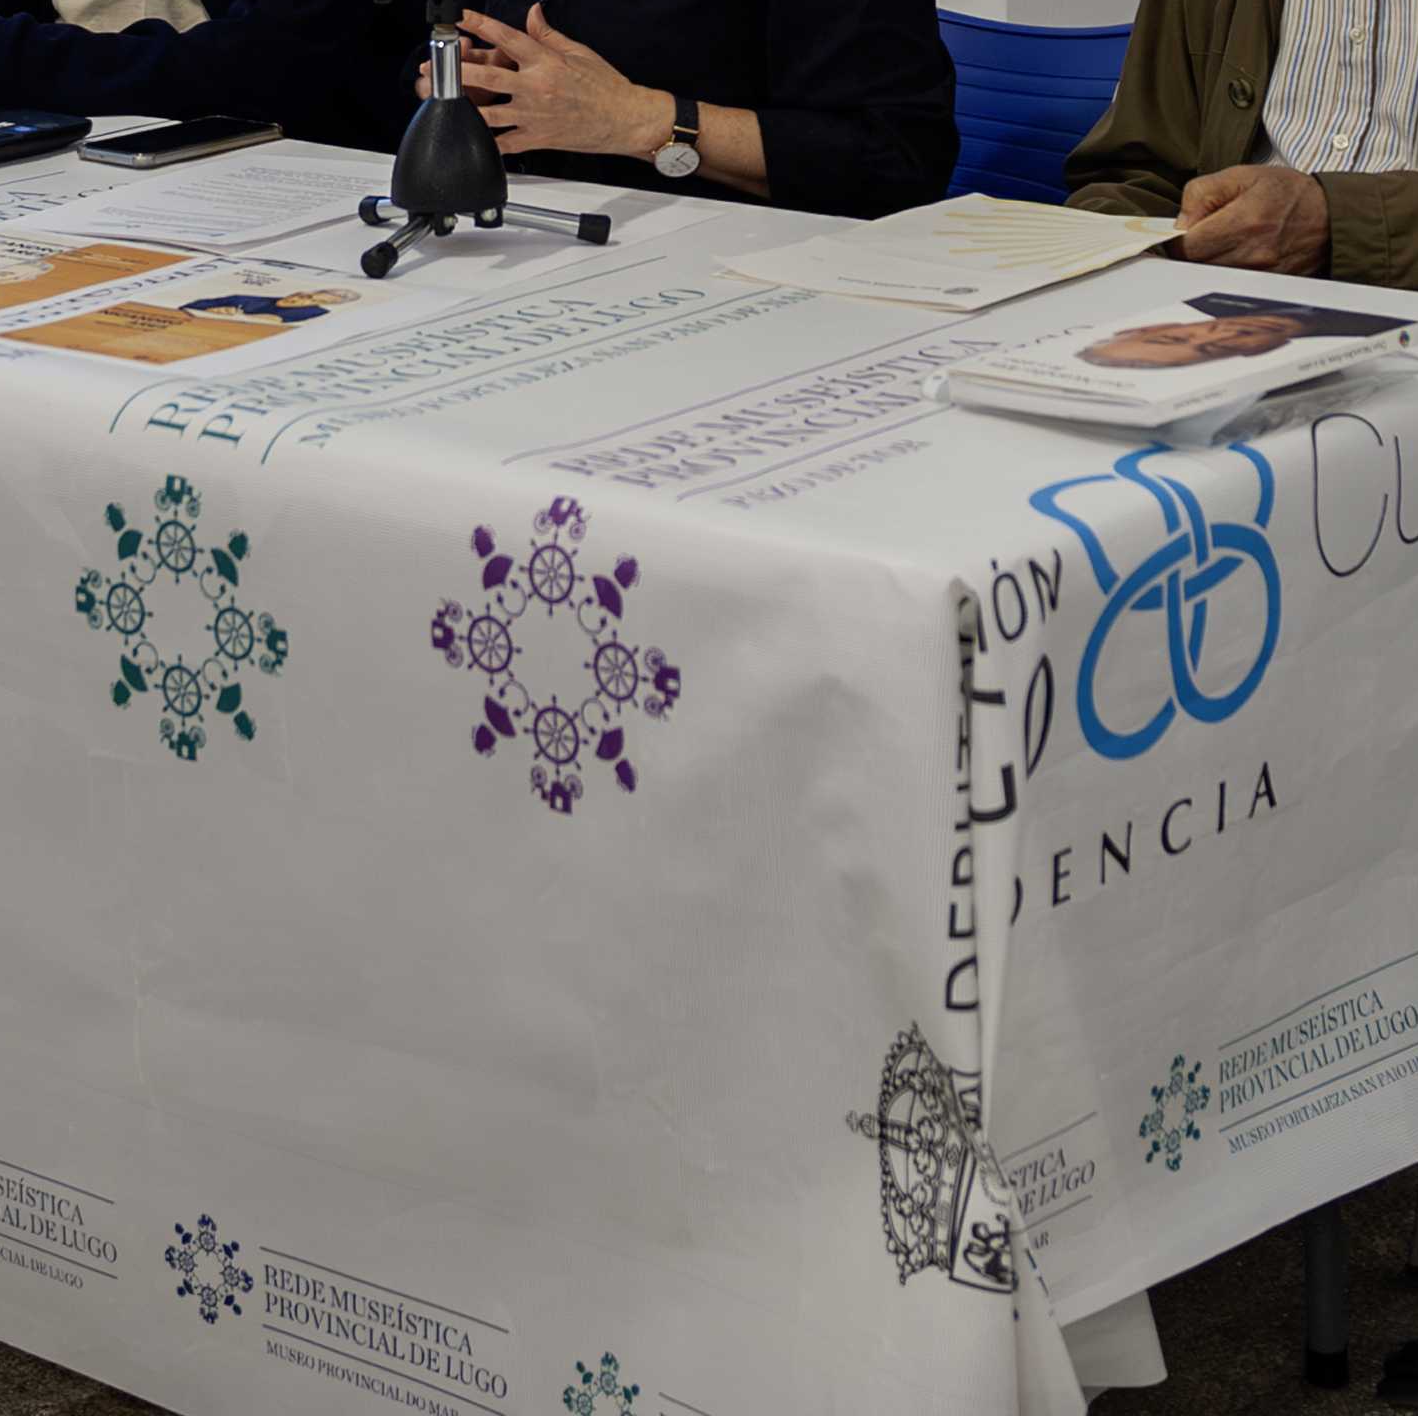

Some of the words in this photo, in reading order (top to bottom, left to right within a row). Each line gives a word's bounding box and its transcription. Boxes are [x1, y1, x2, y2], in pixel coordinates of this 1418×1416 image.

[289, 298, 597, 383] MUSEÍSTICA
[569, 287, 706, 327] LUGO
[1218, 1041, 1268, 1084] REDE
[1270, 988, 1384, 1058] MUSEÍSTICA
[1218, 1042, 1335, 1114] PROVINCIAL
[1335, 1028, 1365, 1060] DE
[1227, 1122, 1276, 1155] MUSEO
[1275, 1090, 1352, 1134] FORTALEZA
[1349, 1076, 1378, 1100] SAN
[1378, 1063, 1408, 1088] PAIO
[1038, 1159, 1096, 1207] LUGO
[30, 1213, 57, 1242] DE
[61, 1225, 118, 1264] LUGO
[30, 1258, 48, 1276] DE
[48, 1264, 84, 1289] LUGO
[264, 1263, 326, 1304] REDE
[330, 1285, 473, 1357] MUSEÍSTICA
[265, 1290, 405, 1360] PROVINCIAL
[409, 1341, 441, 1373] DE
[445, 1355, 508, 1399] LUGO
[266, 1340, 315, 1370] MUSEO
[317, 1355, 404, 1404] PROVINCIAL
[406, 1391, 427, 1411] DO
